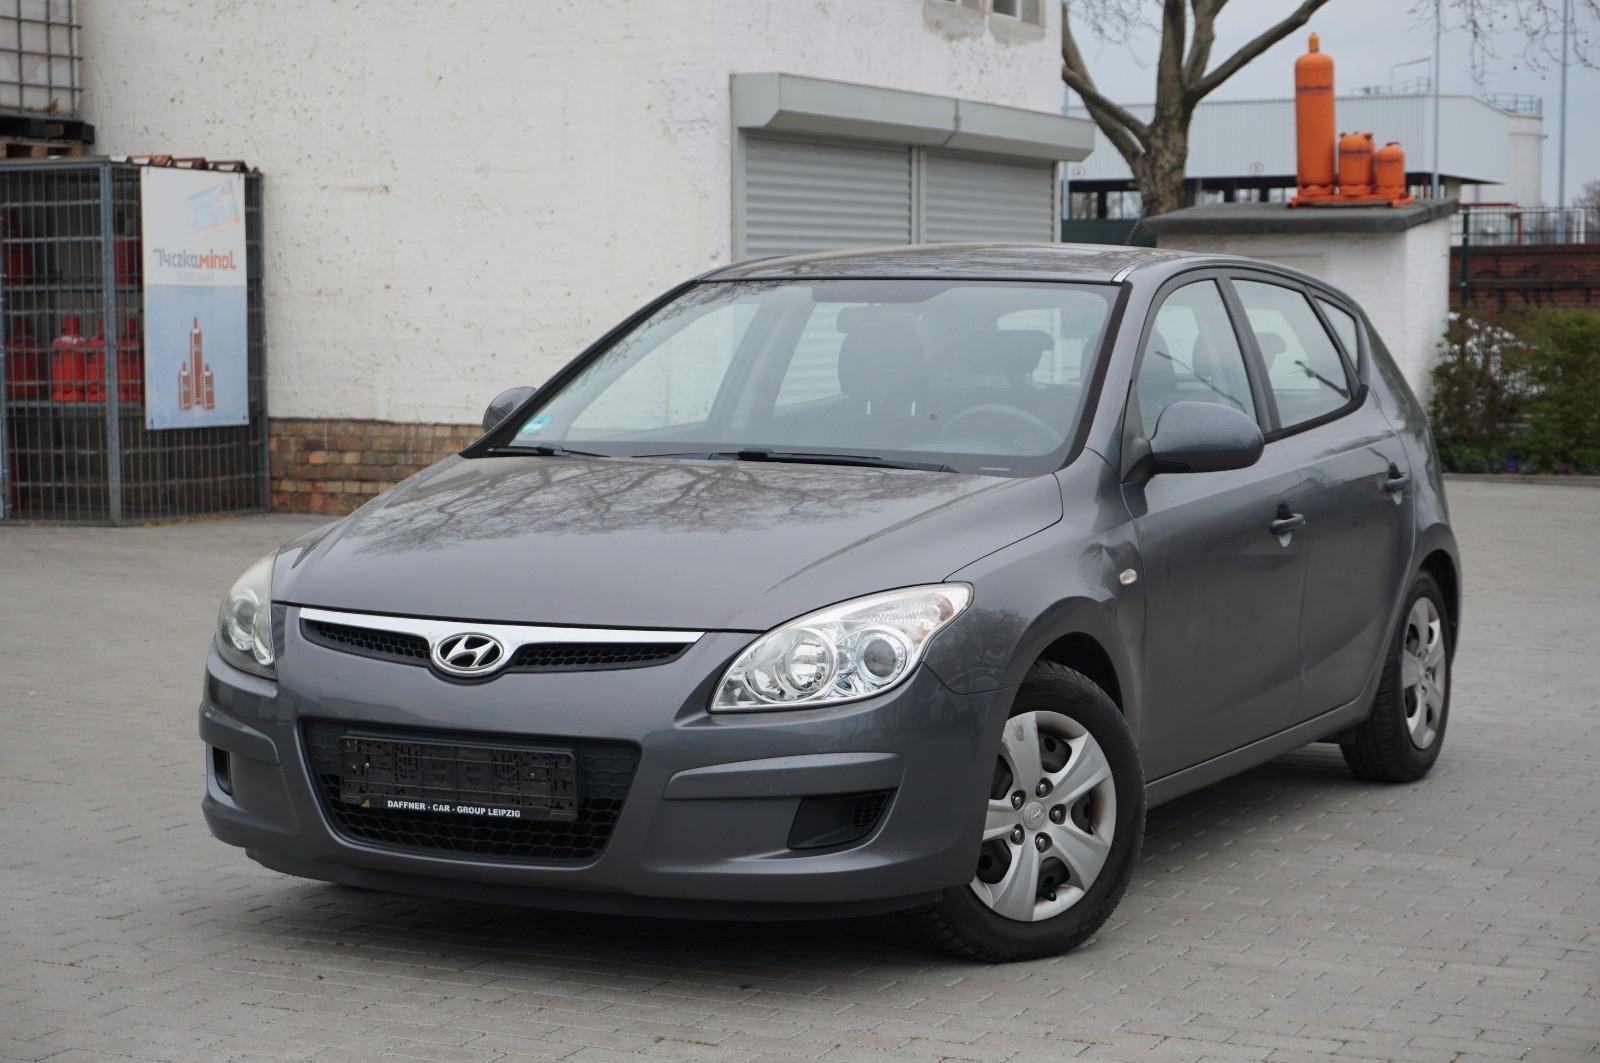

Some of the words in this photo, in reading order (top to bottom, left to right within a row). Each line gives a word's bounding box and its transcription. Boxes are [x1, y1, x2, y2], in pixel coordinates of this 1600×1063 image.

[387, 800, 426, 809] DAFFNER
[432, 804, 450, 812] CAR
[457, 807, 486, 815] GROUP
[488, 809, 521, 817] LEIPZIG
